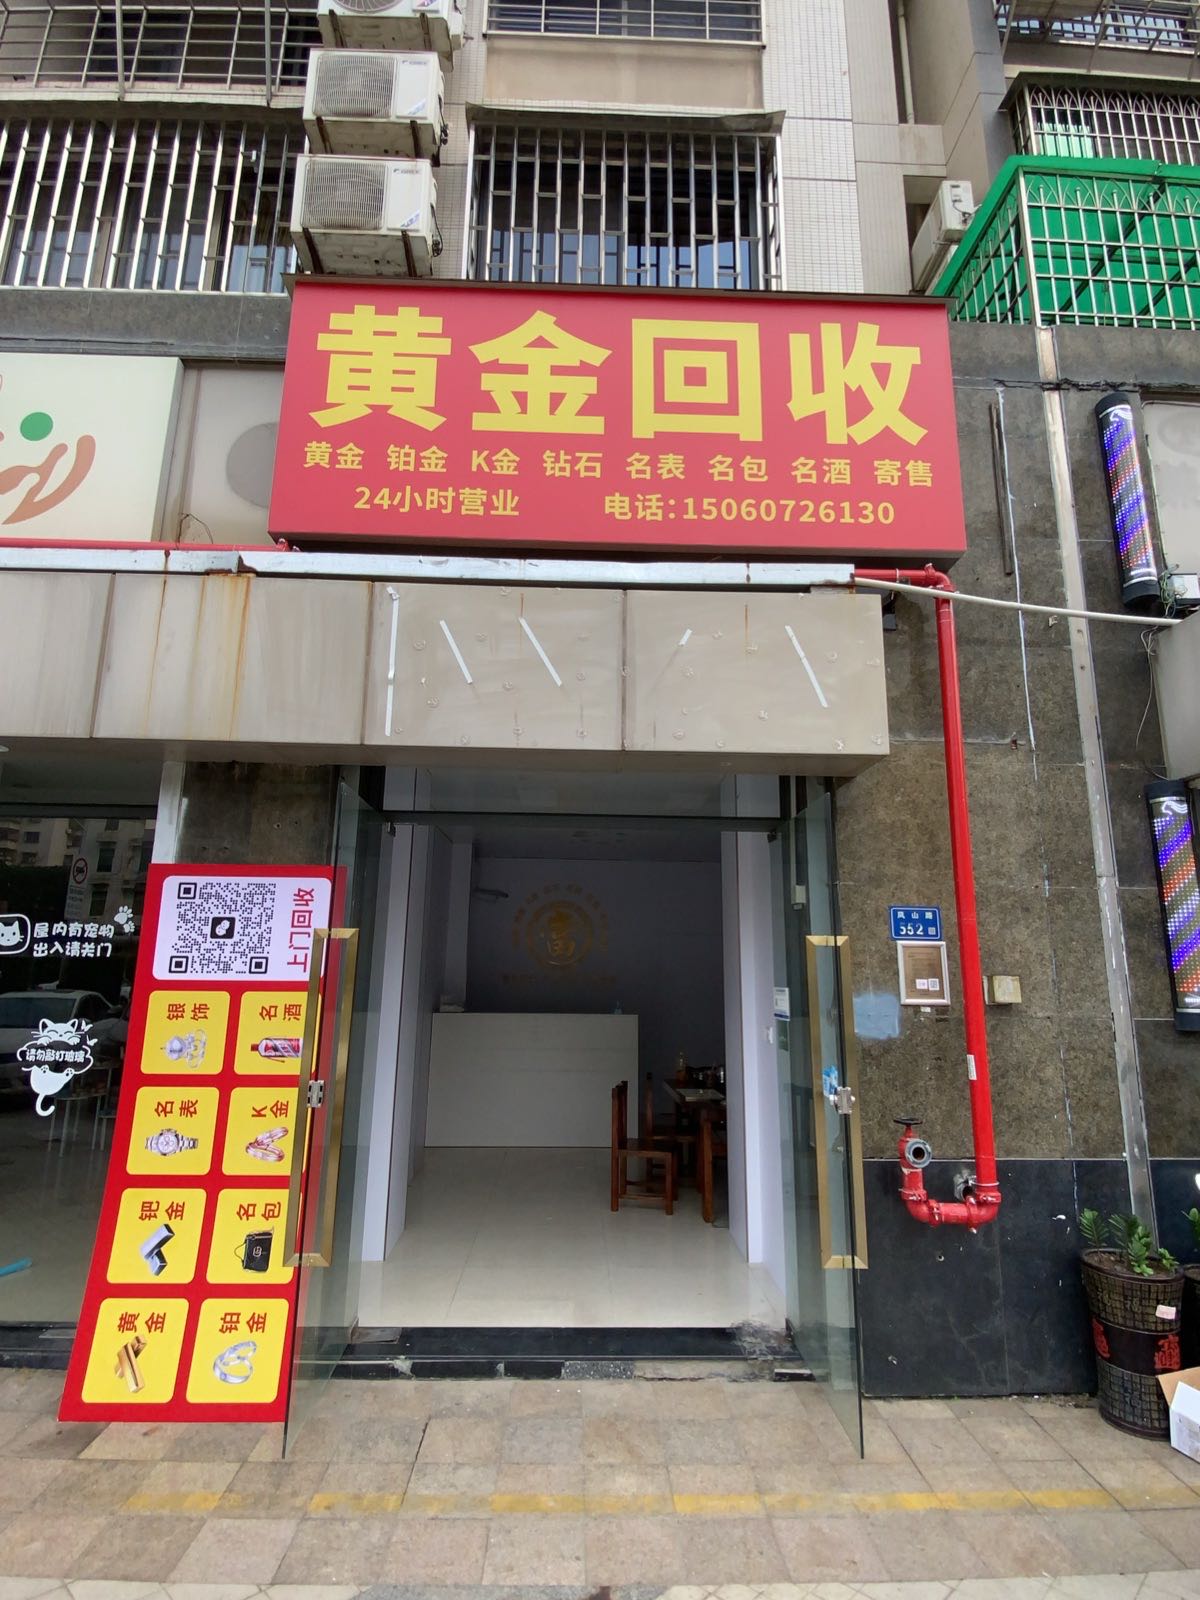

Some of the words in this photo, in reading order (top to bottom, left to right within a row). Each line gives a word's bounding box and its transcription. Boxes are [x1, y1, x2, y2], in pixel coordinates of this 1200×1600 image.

[309, 305, 928, 446] 黄金回收
[303, 441, 365, 470] 黄金
[387, 444, 448, 472] 铂金
[471, 448, 520, 475] K金
[542, 450, 603, 478] 钻石
[625, 452, 686, 480] 名表
[707, 455, 768, 482] 名包
[791, 457, 851, 485] 名酒
[873, 459, 933, 487] 寄售
[353, 485, 520, 516] 24小时营业
[33, 922, 115, 939] 屋内有宠物
[287, 888, 315, 973] 上门回收
[900, 922, 924, 935] 552
[33, 942, 112, 958] 出入请关门
[166, 1003, 210, 1021] 银饰
[259, 1003, 303, 1021] 名酒
[25, 1049, 86, 1063] 请勿敲打玻璃
[154, 1099, 198, 1118] 名表
[251, 1100, 289, 1118] K金
[138, 1200, 186, 1221] 钯金
[236, 1201, 281, 1221] 名包
[117, 1311, 167, 1333] 黄金
[219, 1312, 268, 1333] 铂金
